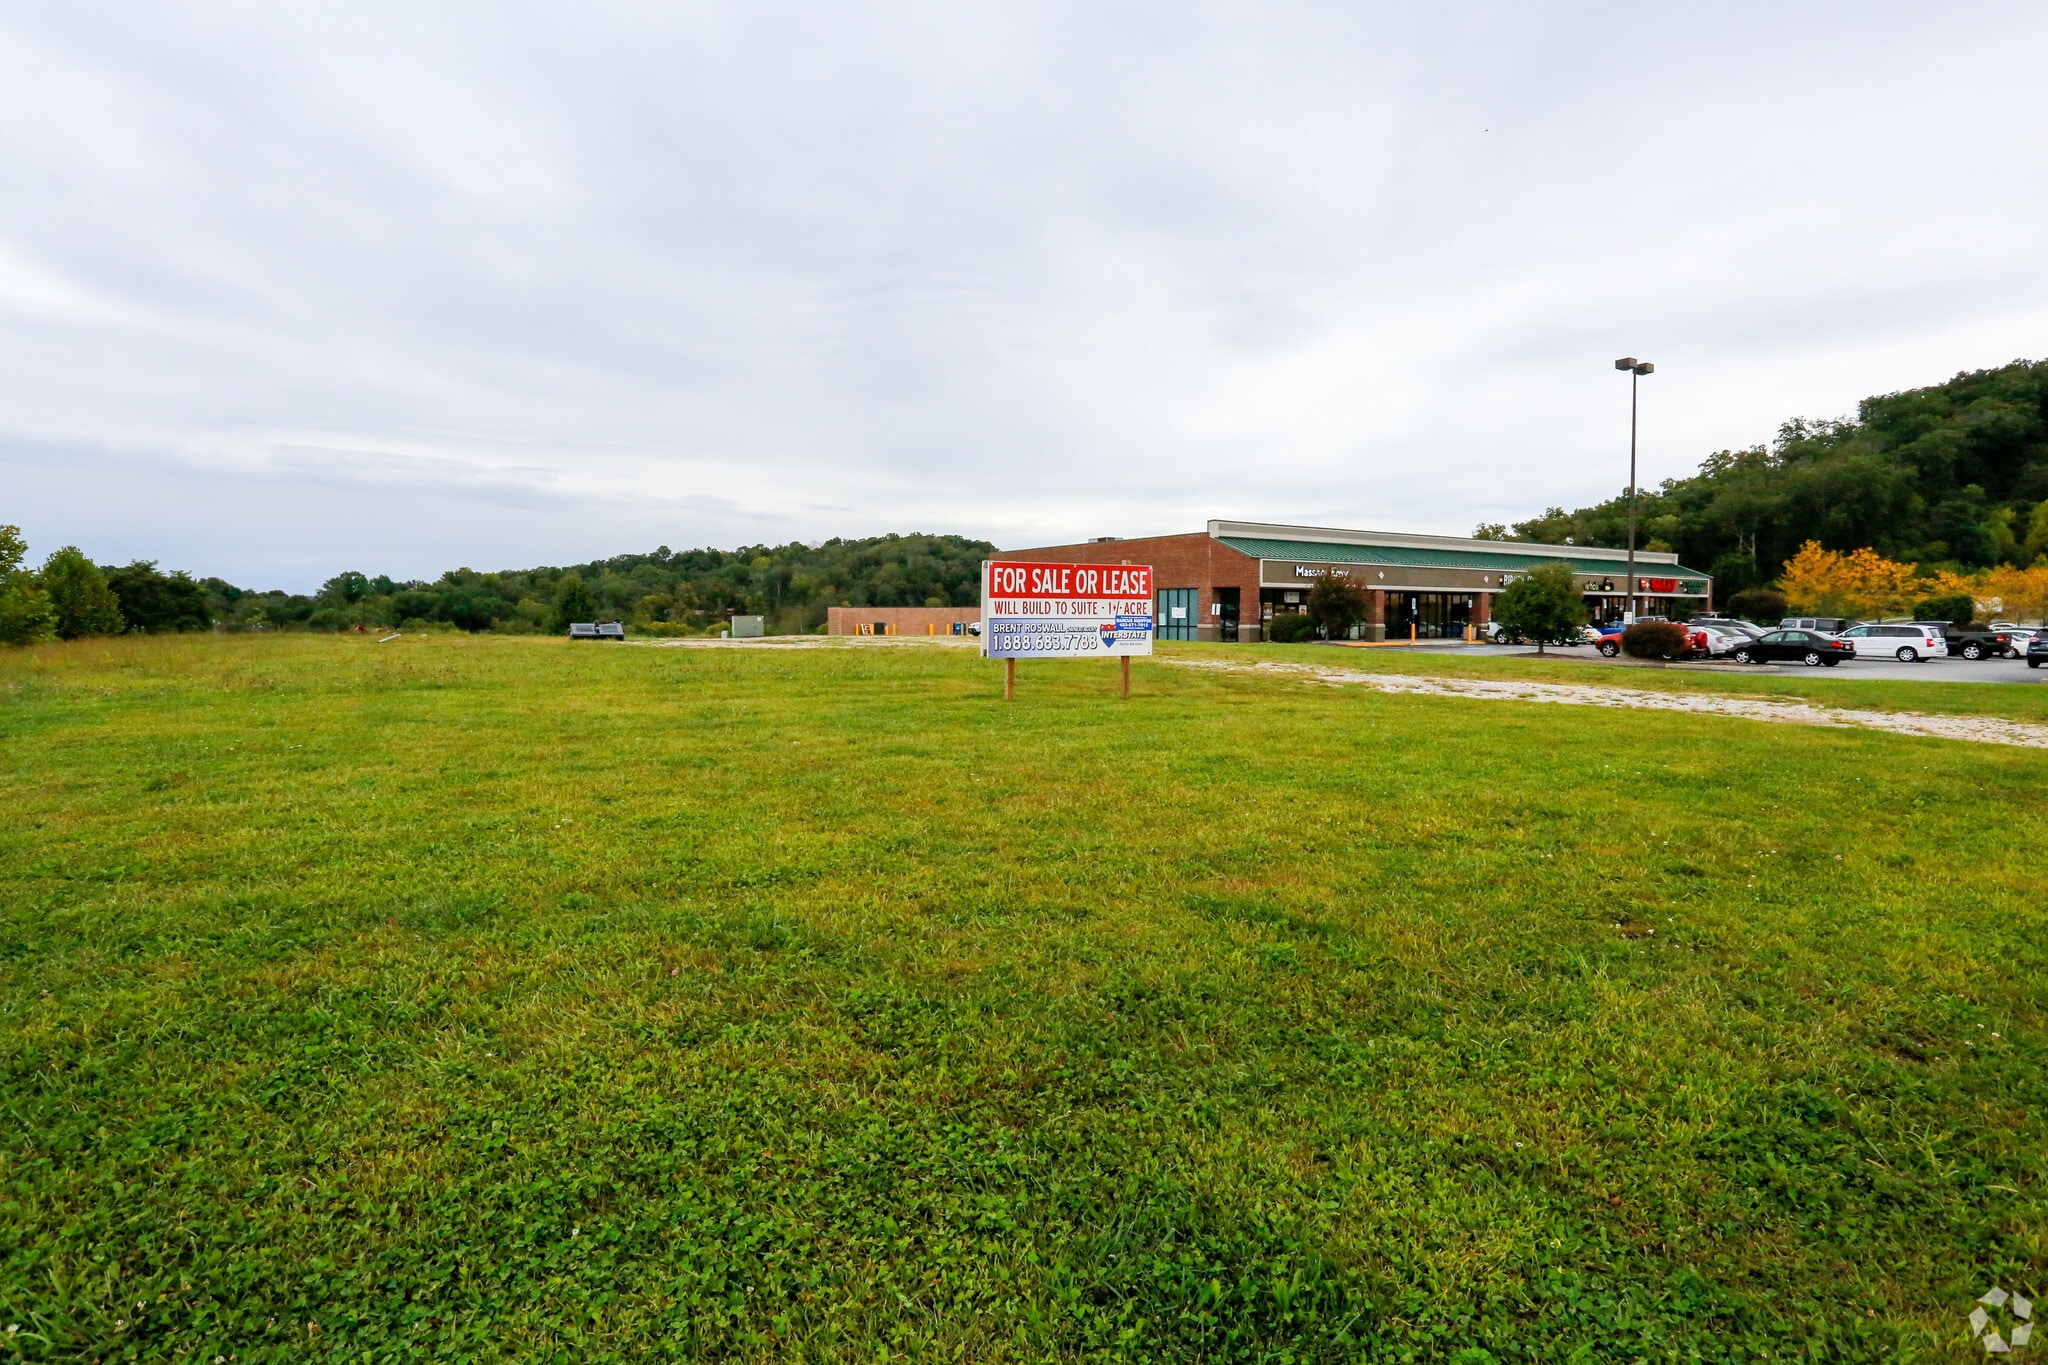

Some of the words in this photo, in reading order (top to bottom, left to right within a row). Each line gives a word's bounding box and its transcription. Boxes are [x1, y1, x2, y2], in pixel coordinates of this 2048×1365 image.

[994, 567, 1026, 593] FOR
[1031, 568, 1070, 594] SALE
[1075, 569, 1097, 594] OR
[1102, 570, 1148, 595] LEASE
[994, 601, 1018, 615] WILL
[1022, 601, 1050, 615] BUILD
[1056, 601, 1068, 615] TO
[1071, 601, 1097, 615] SUITE
[1124, 602, 1147, 615] ACRE
[993, 623, 1022, 633] BRENT
[1026, 623, 1066, 633] ROSWALL
[1101, 630, 1147, 640] INTERSTATE
[993, 634, 1098, 651] 1.888.683.7788
